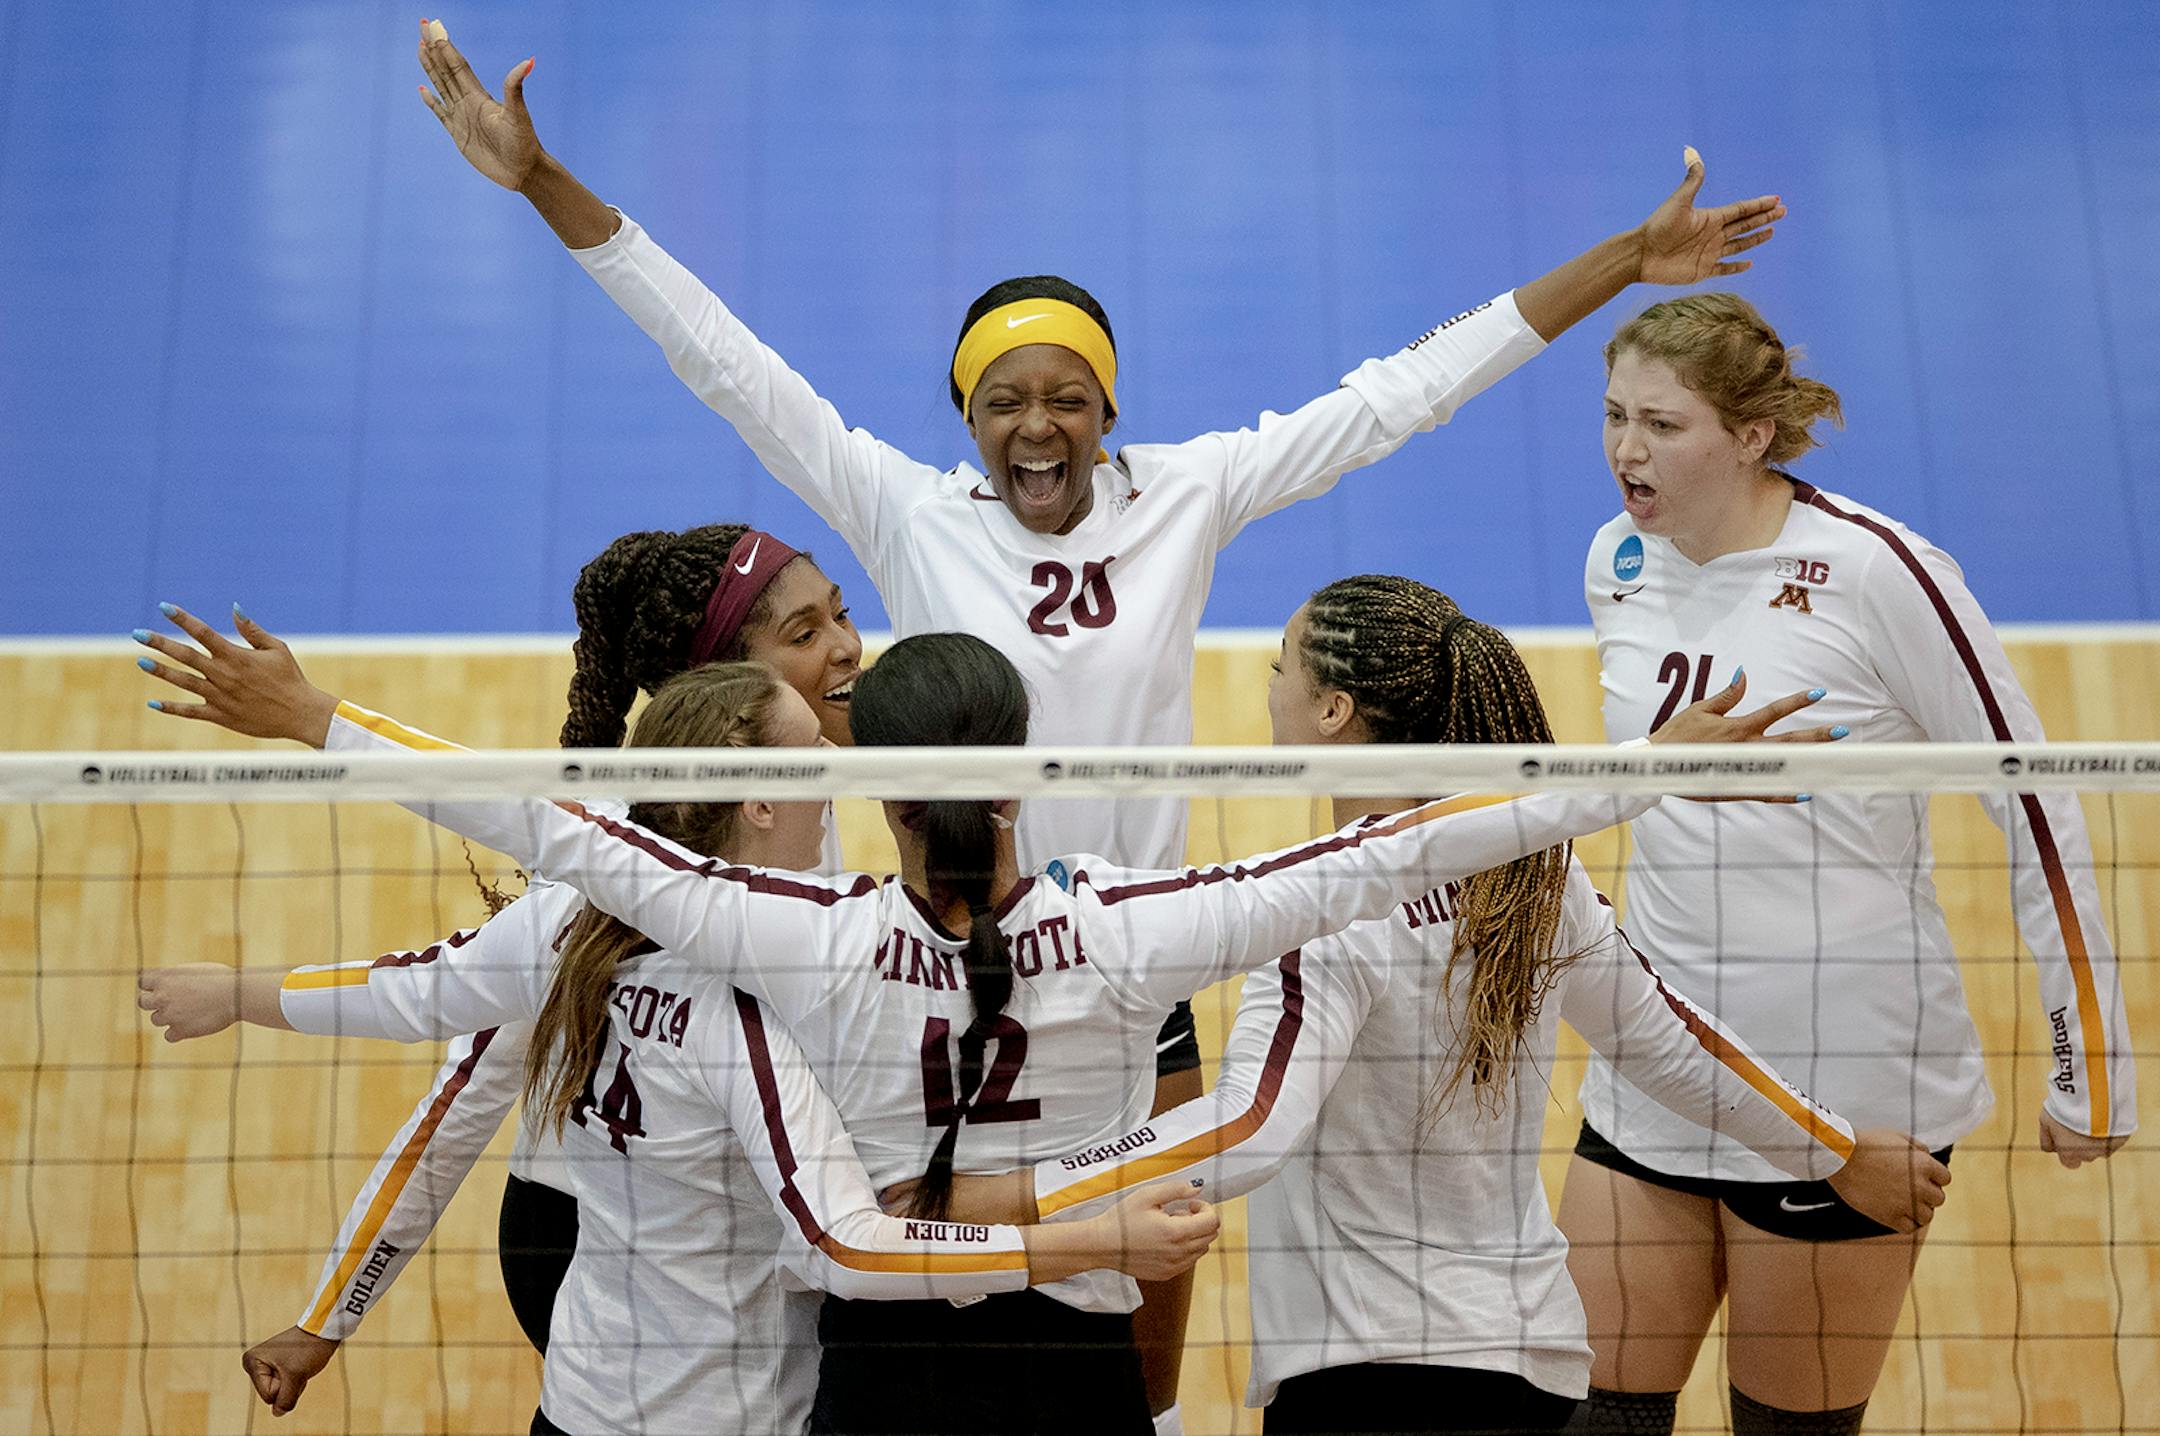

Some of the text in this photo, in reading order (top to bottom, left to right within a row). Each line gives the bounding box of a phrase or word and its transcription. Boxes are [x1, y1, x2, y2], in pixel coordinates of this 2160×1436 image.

[1027, 555, 1117, 638] 20
[1768, 582, 1813, 615] M
[920, 1014, 1042, 1128] 12
[2050, 1006, 2076, 1095] GOPHERS
[1060, 1126, 1158, 1171] GOPHERS
[904, 1222, 989, 1242] GOLDEN
[345, 1238, 401, 1317] GOLDEN
